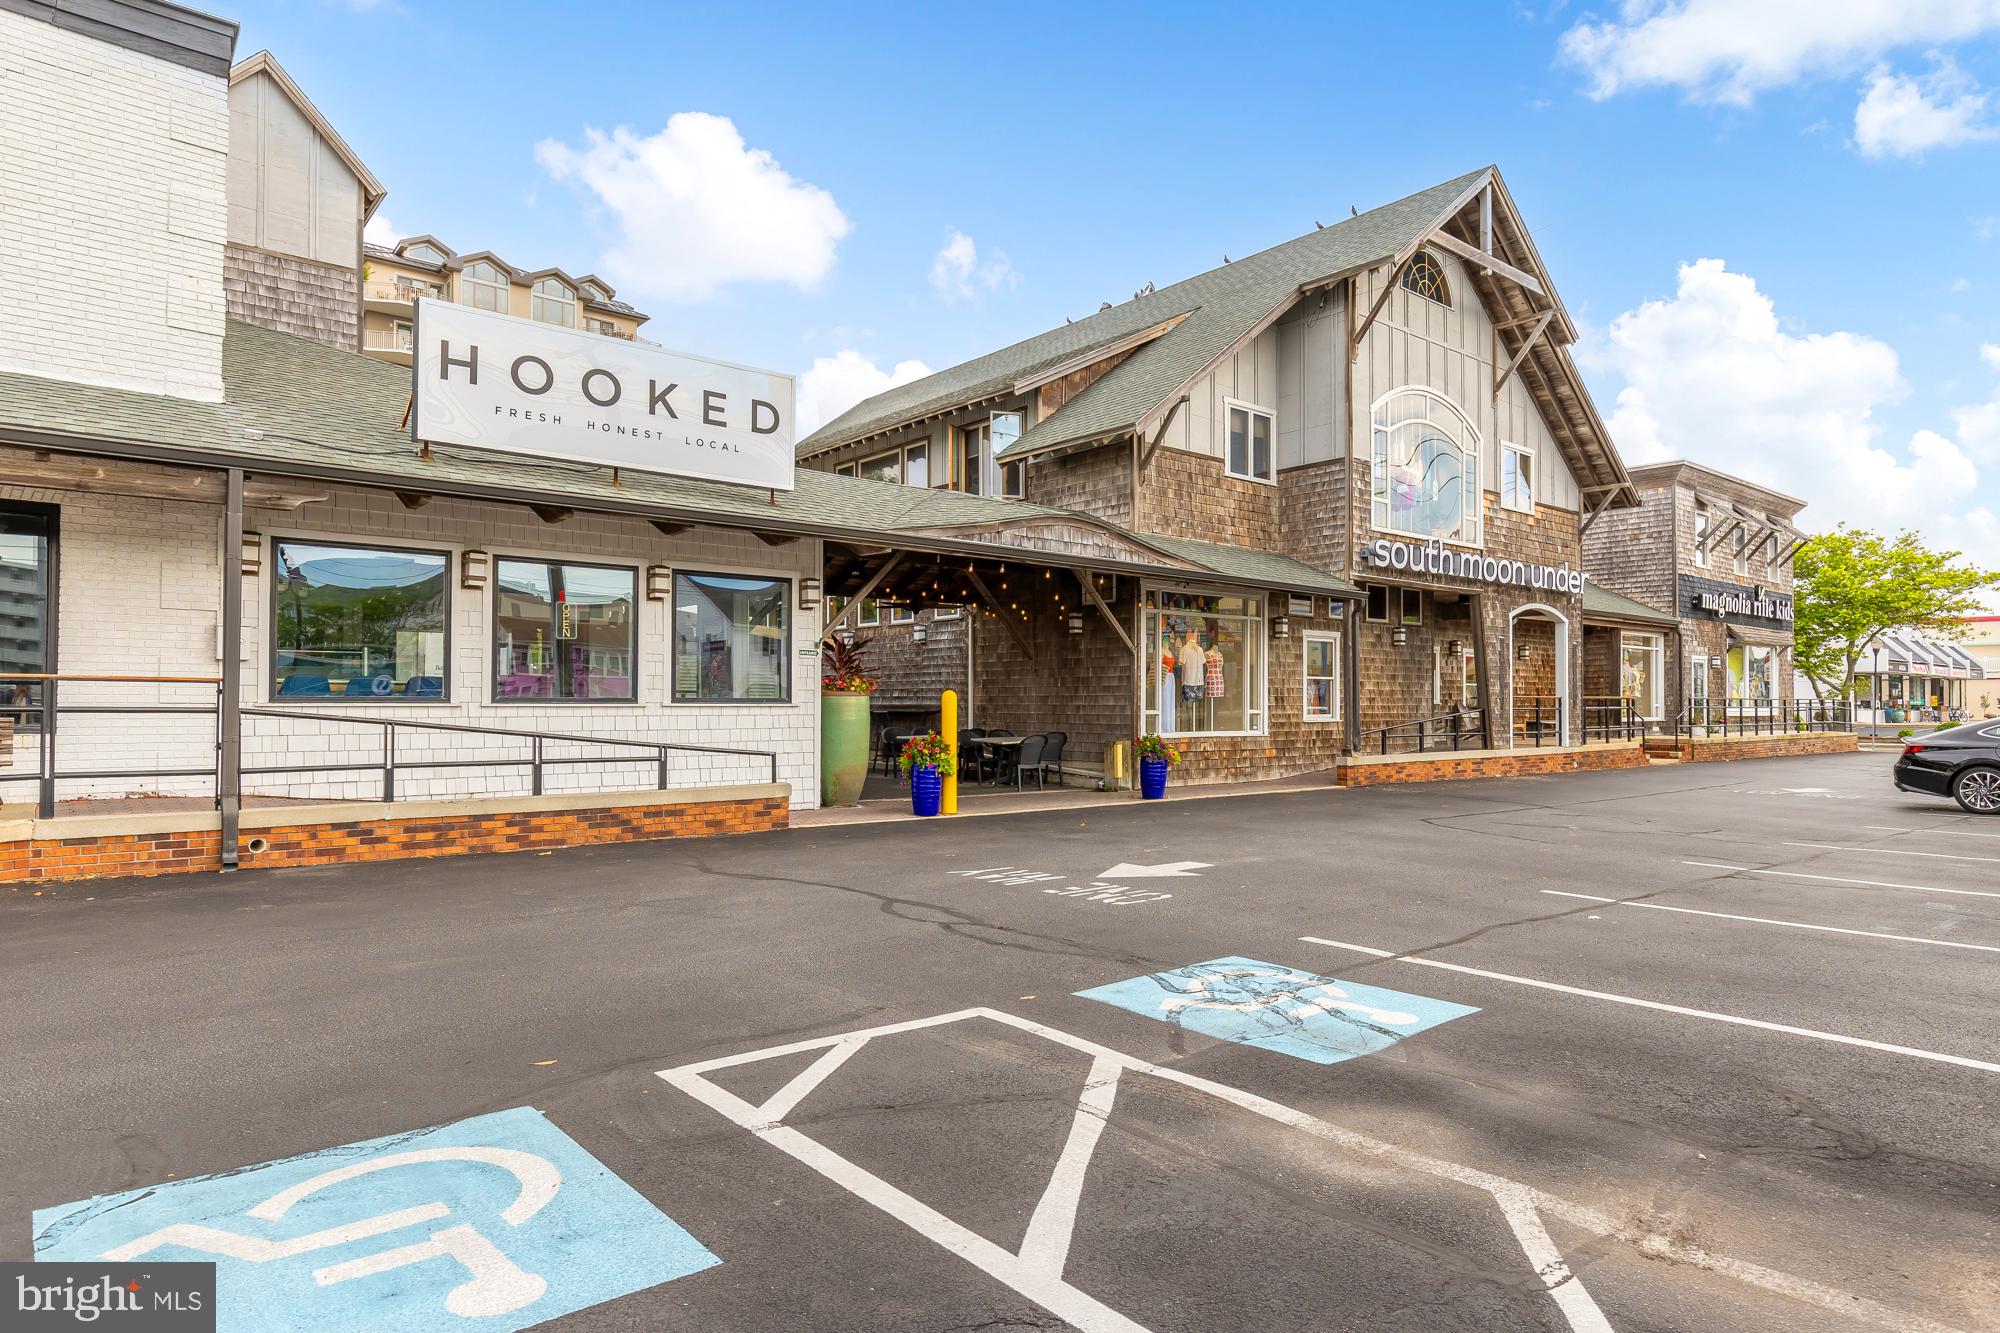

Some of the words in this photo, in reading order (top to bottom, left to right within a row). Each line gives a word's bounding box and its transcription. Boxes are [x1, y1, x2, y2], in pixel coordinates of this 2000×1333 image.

[440, 339, 780, 435] HOOKED
[495, 406, 562, 425] FRESH
[587, 420, 663, 441] HONEST
[685, 436, 740, 453] LOCAL
[1374, 539, 1454, 575] south
[1460, 552, 1525, 585] moon
[1530, 561, 1590, 595] under
[562, 603, 571, 638] OPEN
[1702, 592, 1752, 619] magnolia
[1753, 595, 1774, 619] rifle
[1775, 599, 1795, 621] kids
[1042, 881, 1173, 905] ONE
